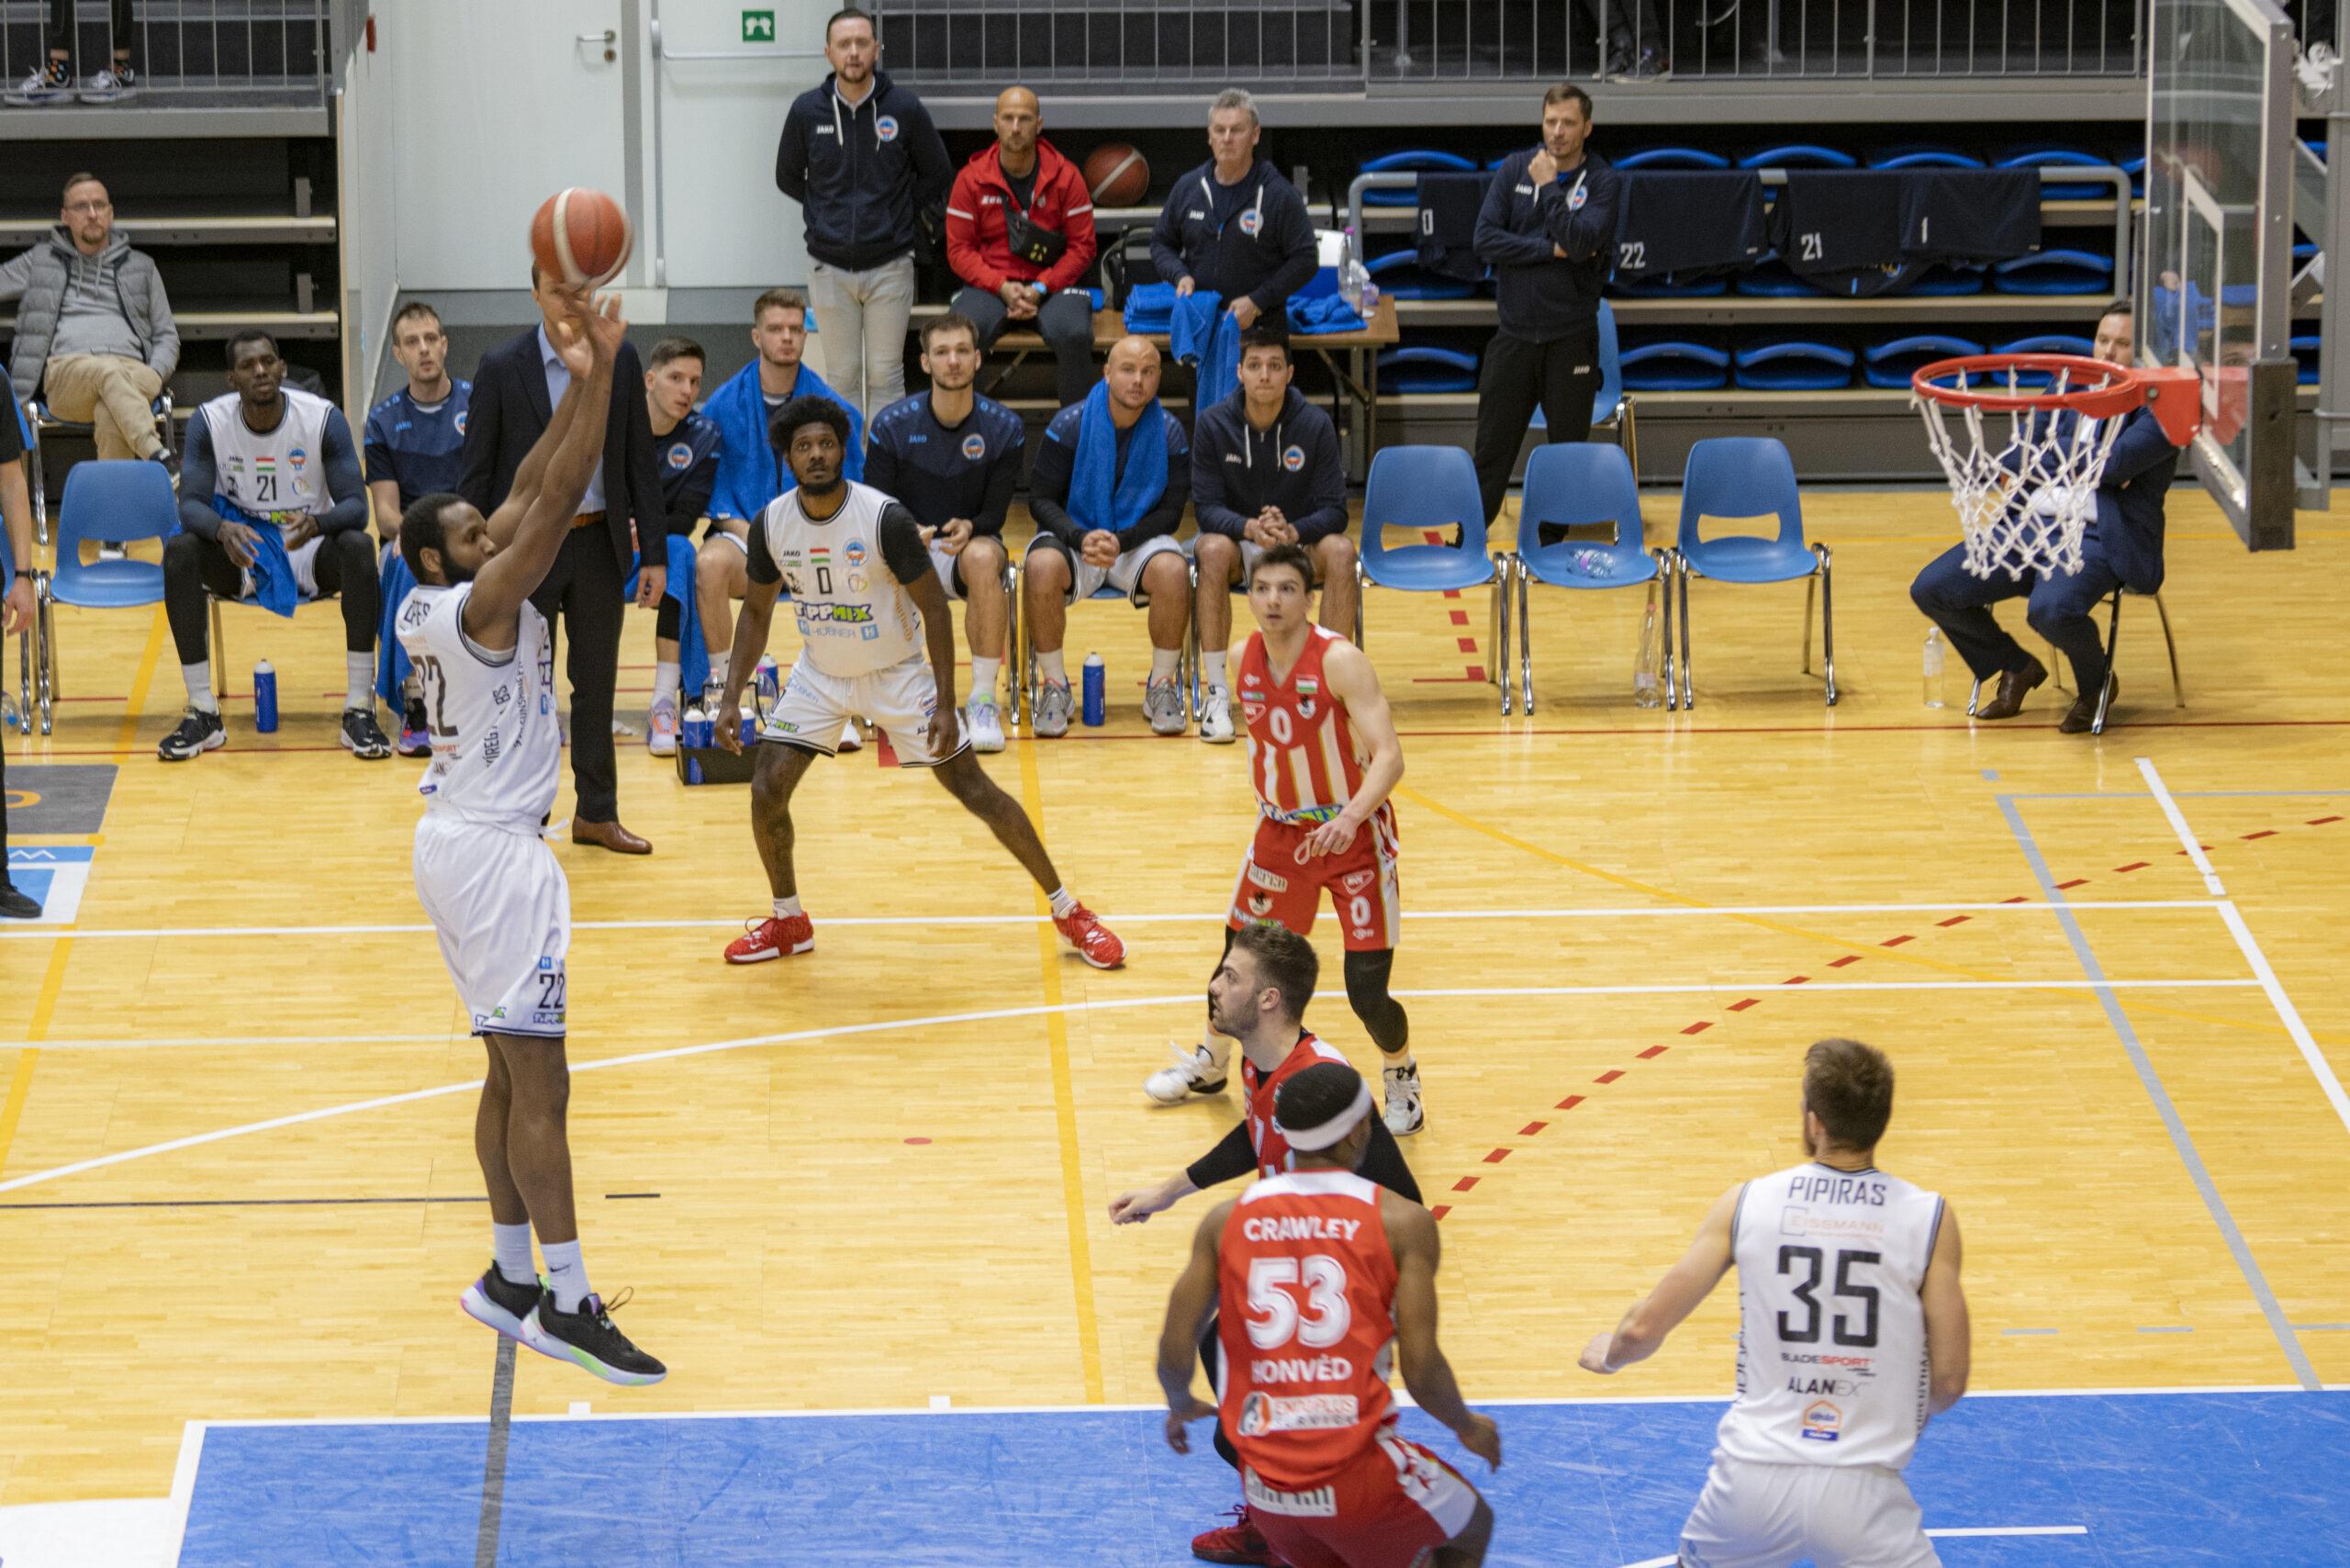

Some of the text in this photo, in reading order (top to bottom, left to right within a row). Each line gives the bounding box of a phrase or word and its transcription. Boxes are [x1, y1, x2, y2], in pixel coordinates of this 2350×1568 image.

[1516, 184, 1533, 196] JAKO
[1619, 241, 1646, 269] 22
[1801, 232, 1822, 261] 21
[257, 475, 277, 502] 21
[782, 549, 801, 558] JAKO
[816, 566, 834, 595] 0
[1270, 705, 1293, 745] 0
[1350, 895, 1371, 926] 0
[538, 972, 565, 1009] 22
[1788, 1176, 1886, 1206] PIPIRAS
[1243, 1215, 1361, 1242] CRAWLEY
[1245, 1254, 1352, 1350] 53
[1777, 1245, 1882, 1348] 35
